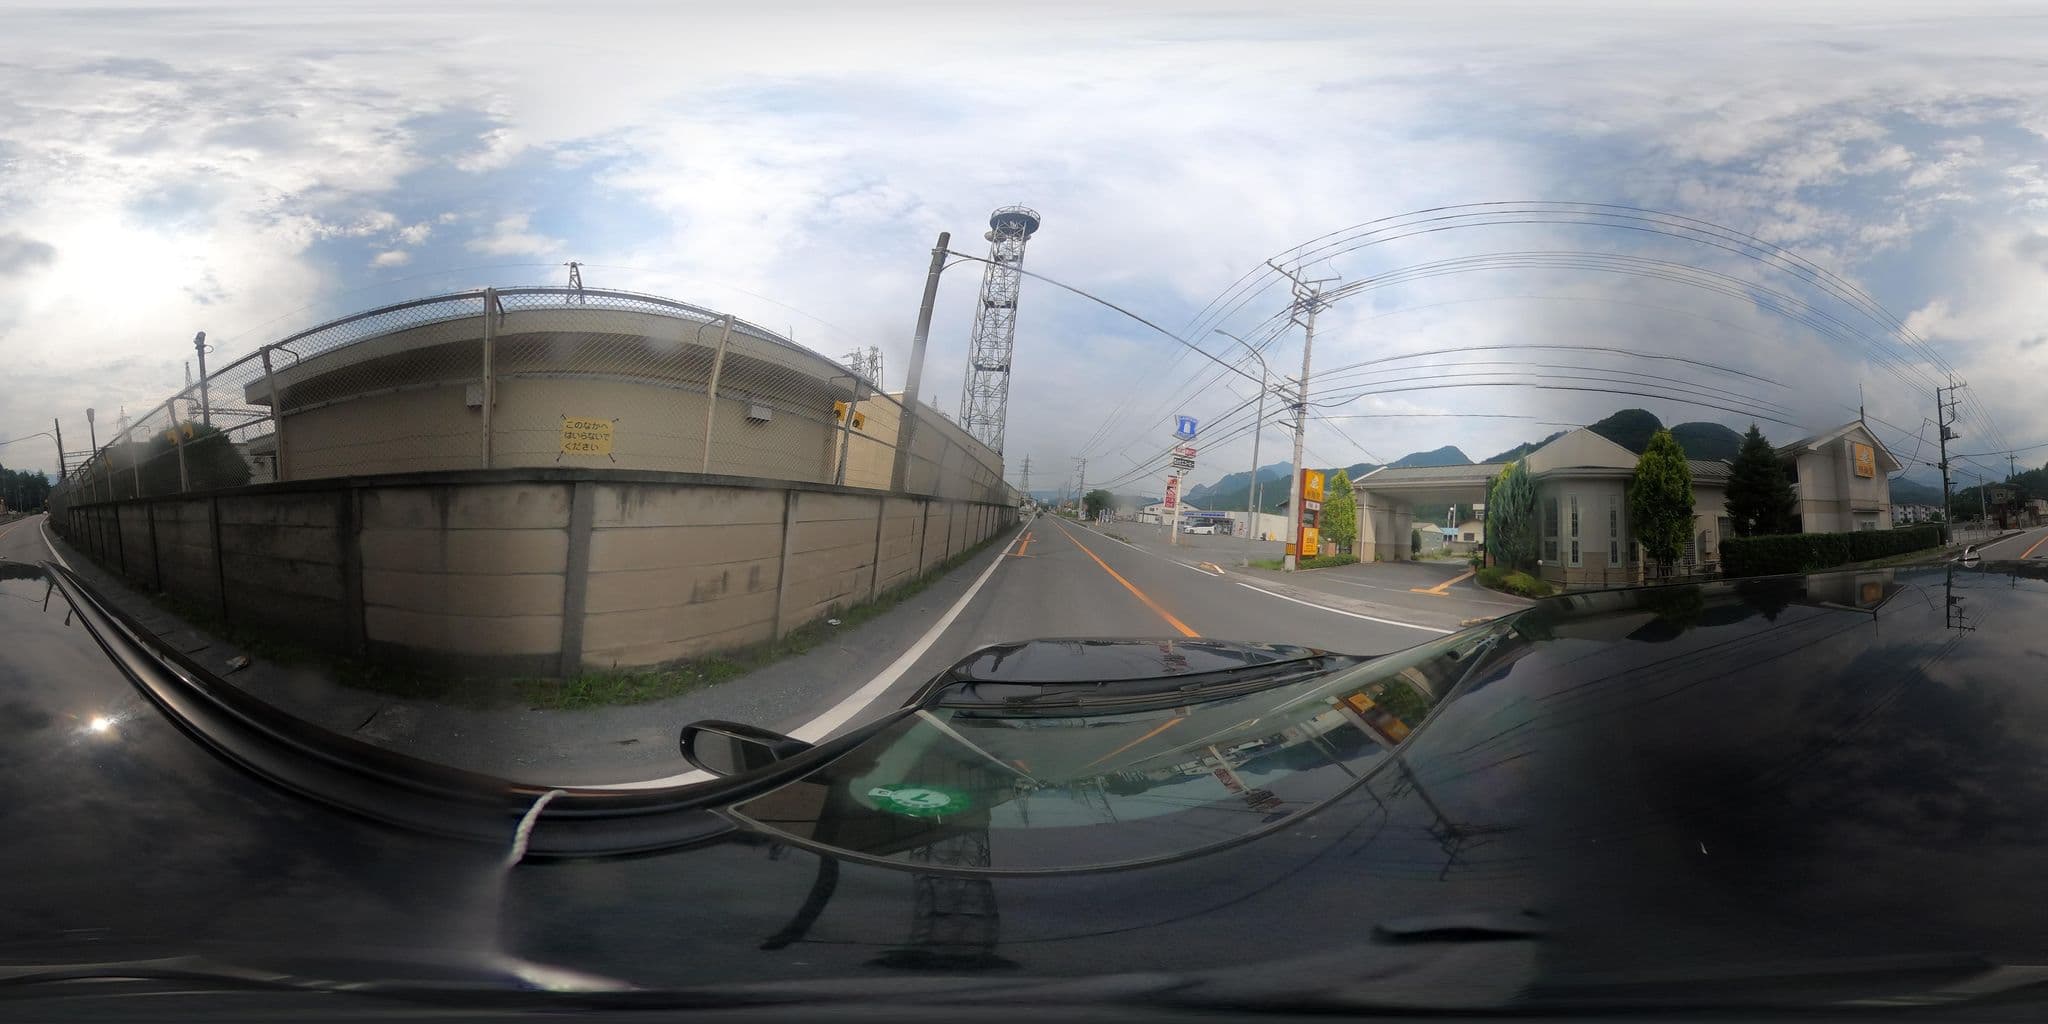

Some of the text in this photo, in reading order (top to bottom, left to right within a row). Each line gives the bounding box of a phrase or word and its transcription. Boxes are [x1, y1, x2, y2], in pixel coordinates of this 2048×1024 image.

[566, 421, 609, 430] このなかへ
[564, 432, 610, 441] はいらないで
[564, 442, 599, 451] ください
